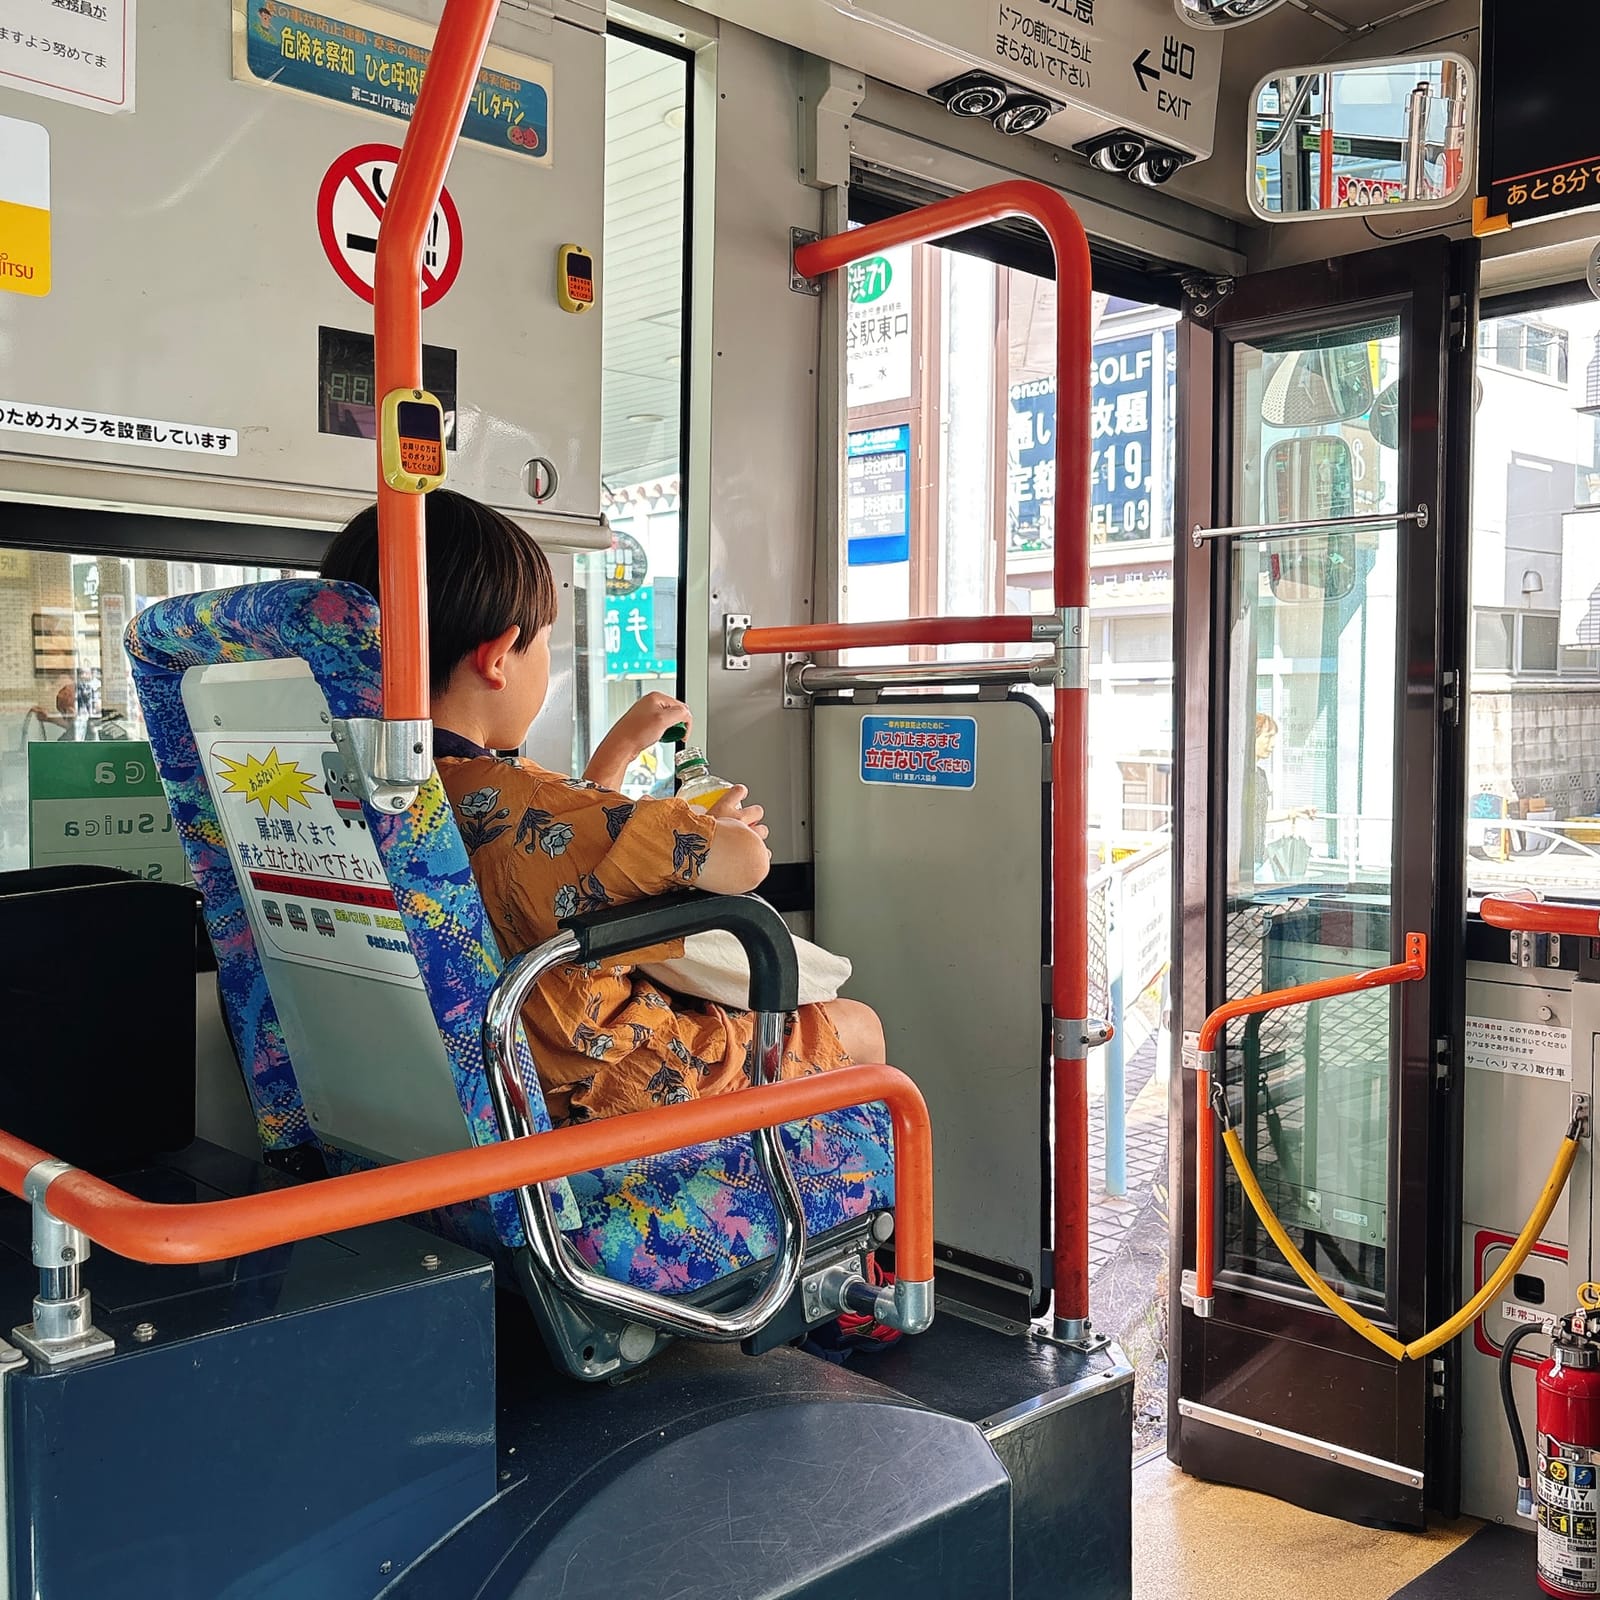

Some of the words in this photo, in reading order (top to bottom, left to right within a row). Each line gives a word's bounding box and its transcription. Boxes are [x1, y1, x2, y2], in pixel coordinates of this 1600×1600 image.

[999, 3, 1092, 64] ドアの前に立ち止
[280, 26, 355, 76] 危険を察知
[364, 54, 426, 97] ひと呼吸
[996, 33, 1092, 89] まらないで下さい
[1161, 34, 1195, 80] 出口
[1157, 89, 1192, 121] EXIT
[402, 442, 437, 453] お降りの方は
[402, 452, 437, 462] このボタンを
[873, 731, 961, 749] バスが止まるまで
[865, 748, 971, 774] 立たないでください
[248, 763, 281, 793] あぶない!
[254, 817, 336, 847] 扉が開くまで
[238, 841, 381, 881] 席を立たないで下さい
[1505, 1306, 1556, 1326] 非常コック
